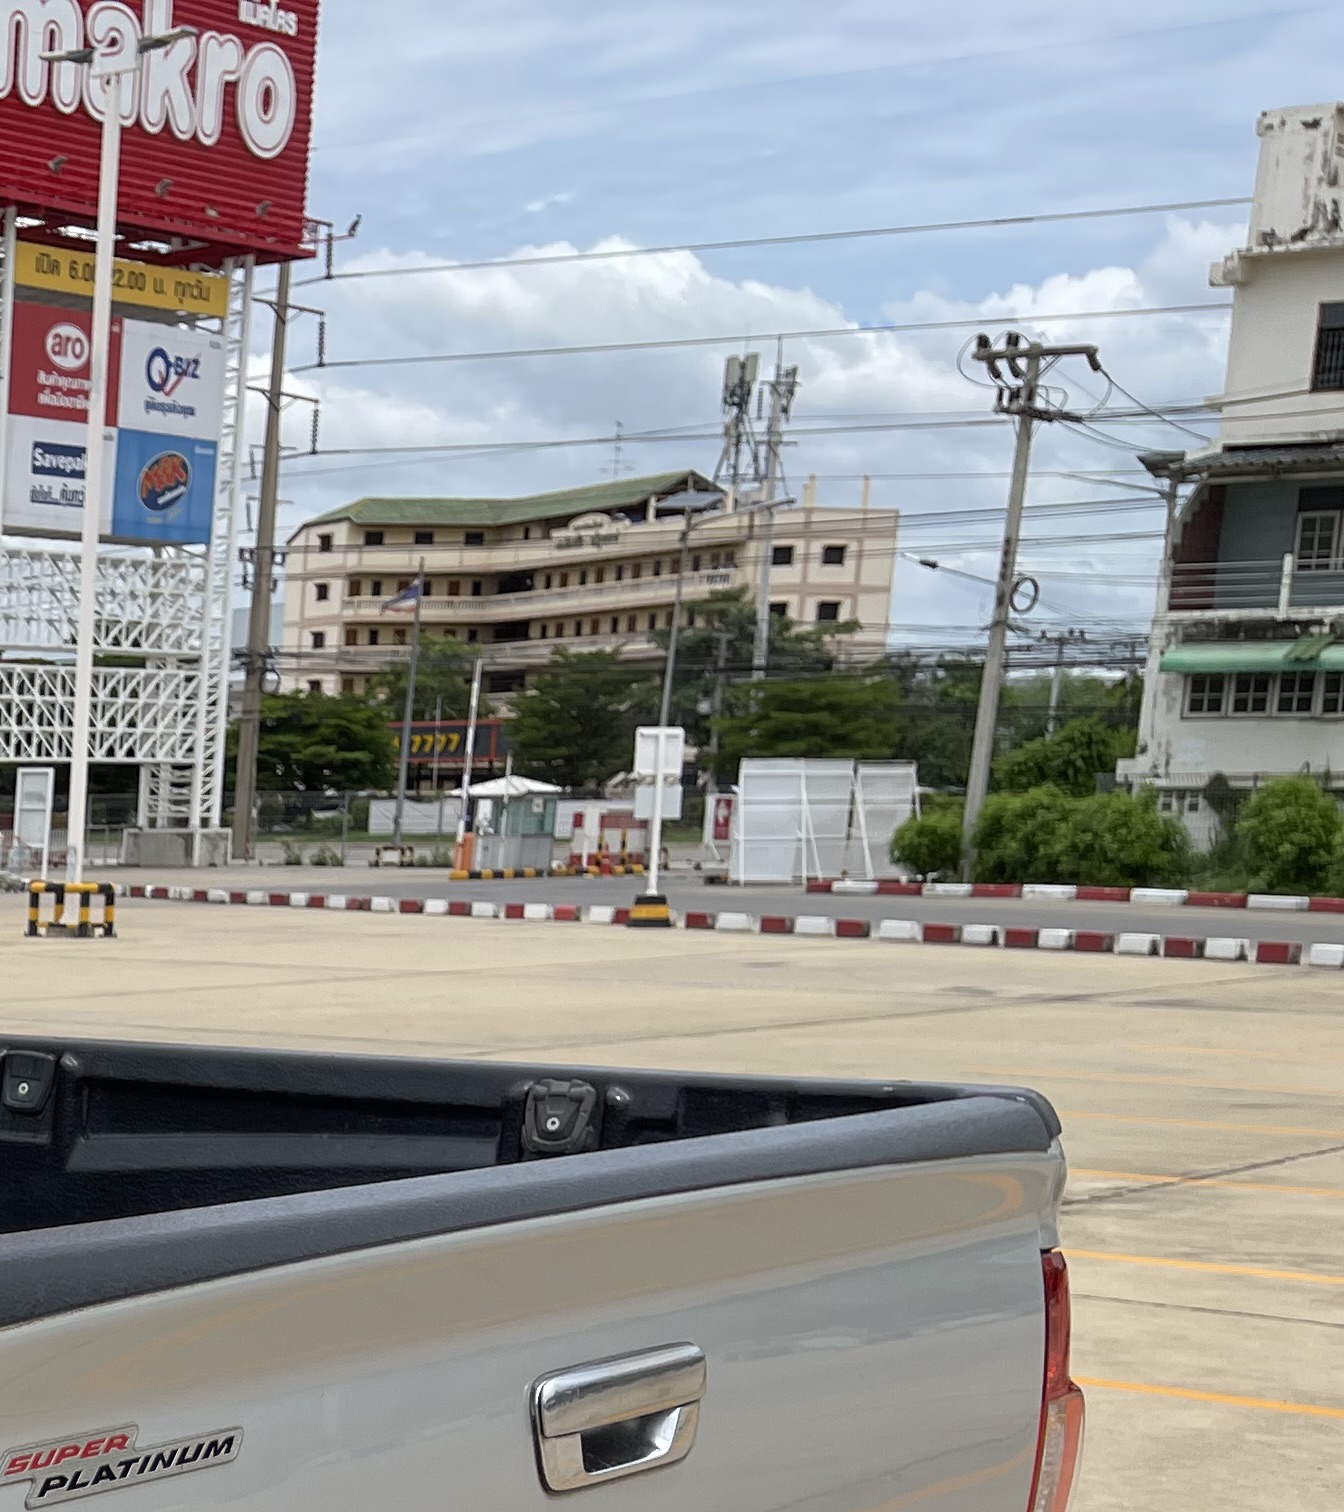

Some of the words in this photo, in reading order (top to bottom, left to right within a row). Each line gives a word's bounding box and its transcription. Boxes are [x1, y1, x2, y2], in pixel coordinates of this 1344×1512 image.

[69, 260, 96, 282] 6.0
[50, 330, 86, 359] aro
[3, 1433, 130, 1476] SUPER
[37, 1435, 235, 1498] PLATINUM
